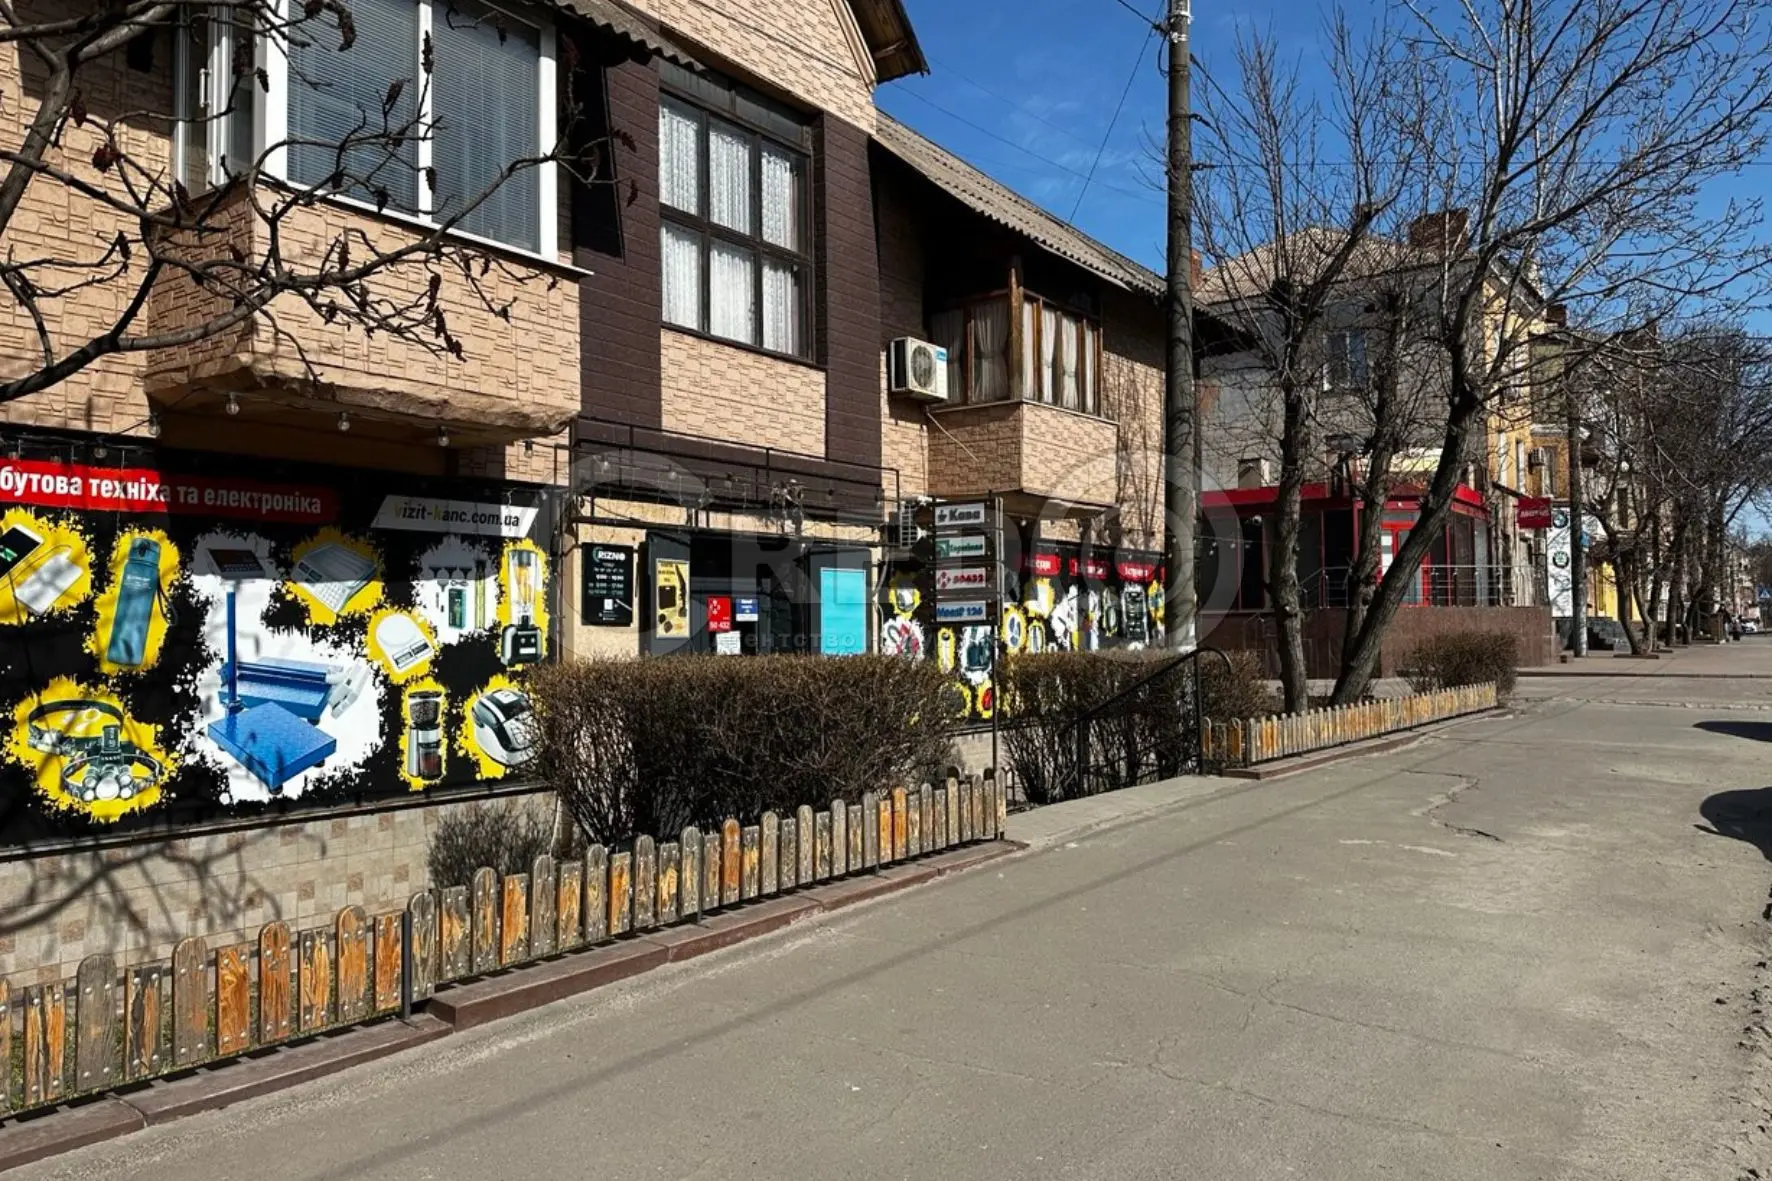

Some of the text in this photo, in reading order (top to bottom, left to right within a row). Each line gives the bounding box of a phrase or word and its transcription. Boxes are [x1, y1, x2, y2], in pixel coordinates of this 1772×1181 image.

[0, 465, 82, 496] бутова
[177, 485, 199, 504] та
[204, 488, 321, 514] електроніка
